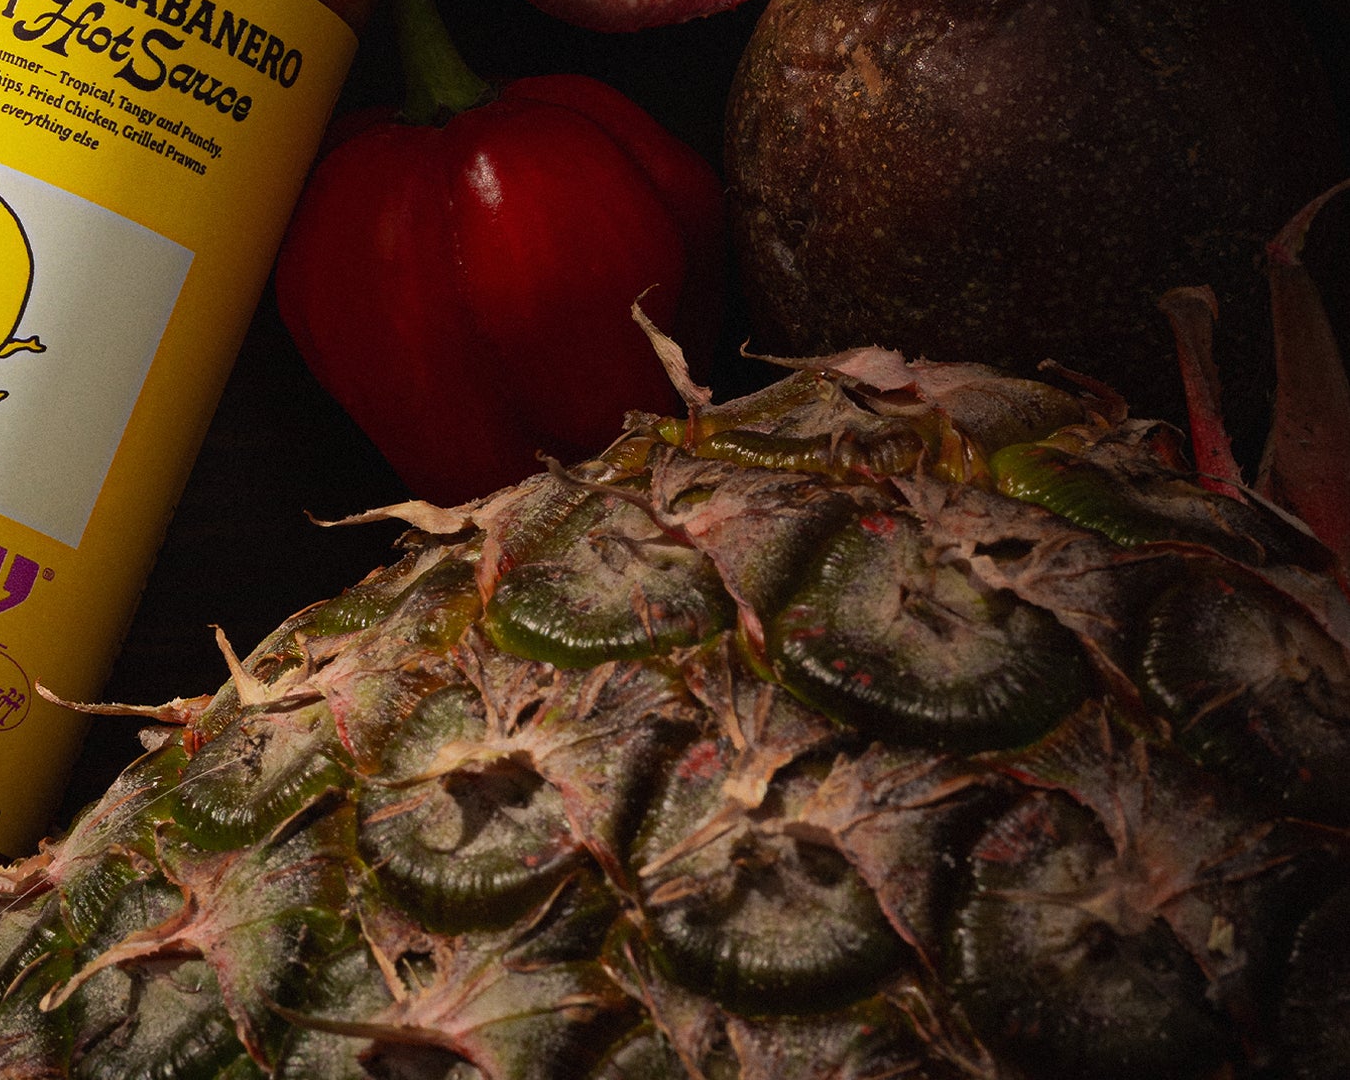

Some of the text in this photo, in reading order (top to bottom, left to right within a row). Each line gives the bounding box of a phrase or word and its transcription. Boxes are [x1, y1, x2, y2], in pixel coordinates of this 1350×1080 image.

[60, 71, 115, 107] Tropical,
[118, 96, 157, 125] Tangy
[156, 117, 183, 136] and
[181, 126, 222, 159] Punchy.
[114, 30, 252, 121] Sauce
[1, 103, 72, 142] everything
[73, 131, 100, 150] else
[27, 84, 65, 109] Fried
[65, 100, 119, 136] Chicken,
[122, 125, 167, 154] Grilled
[165, 145, 207, 175] Prawns
